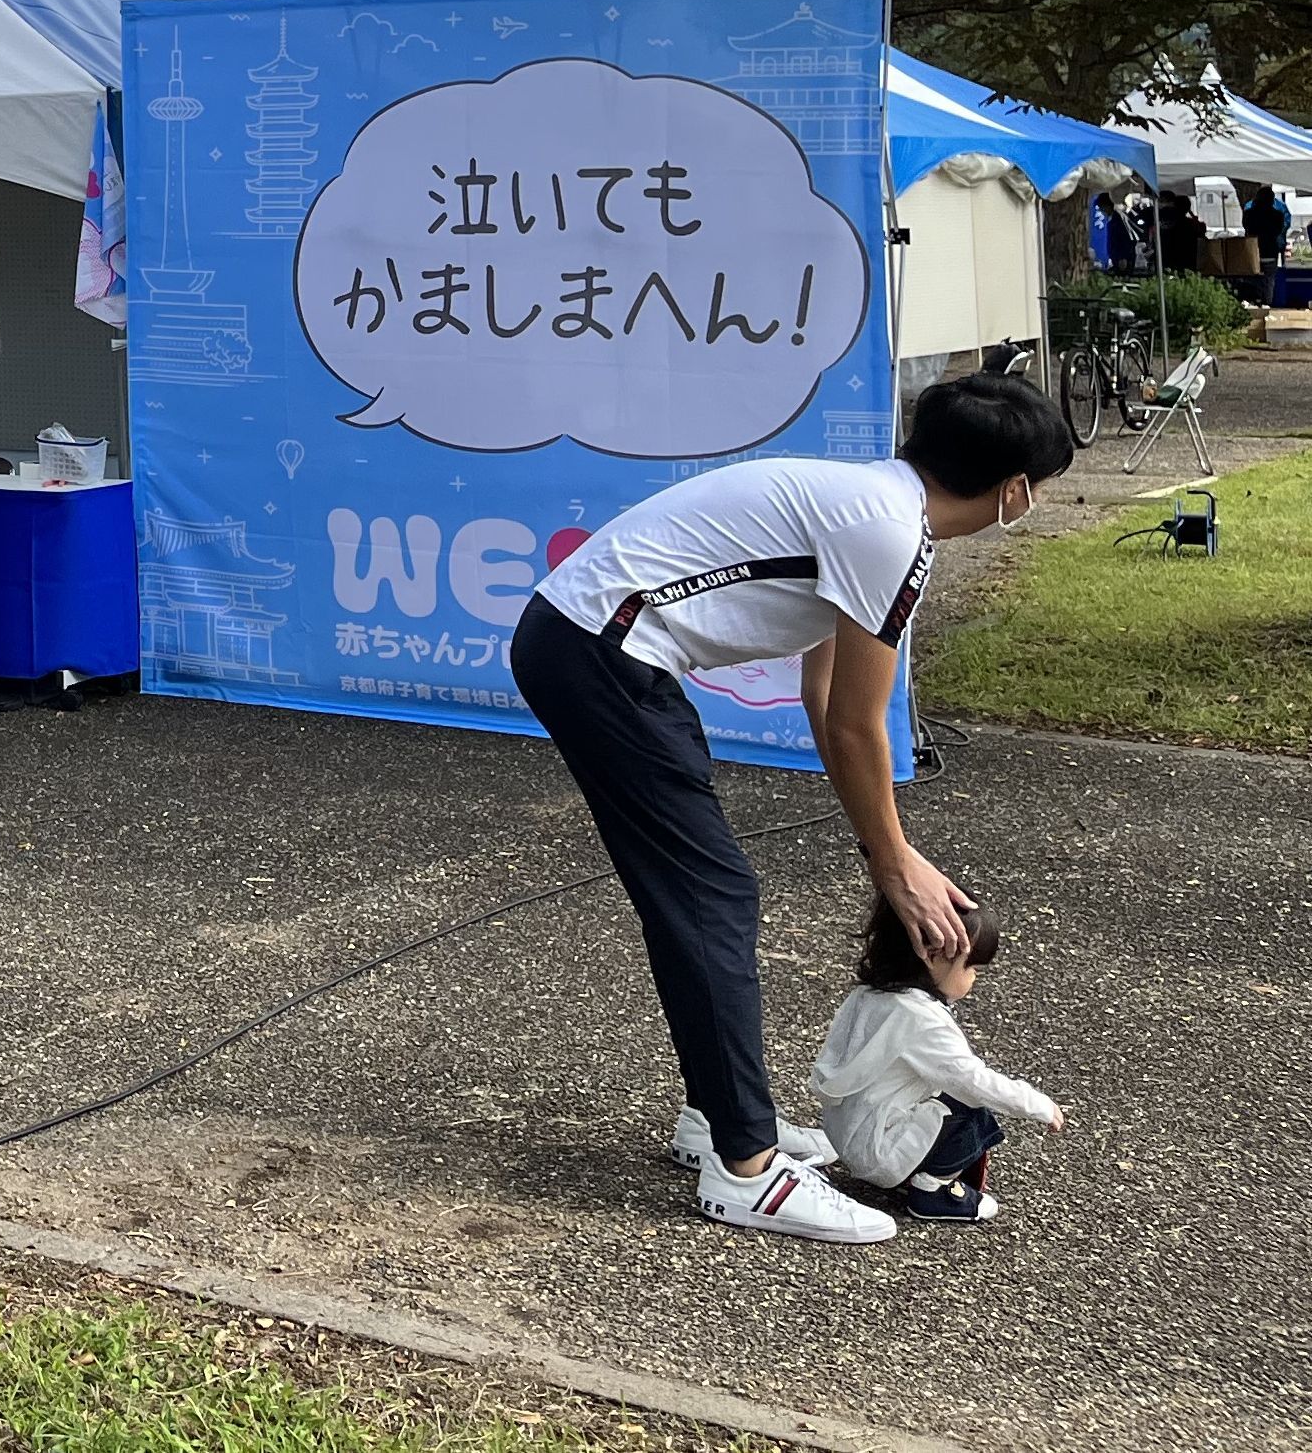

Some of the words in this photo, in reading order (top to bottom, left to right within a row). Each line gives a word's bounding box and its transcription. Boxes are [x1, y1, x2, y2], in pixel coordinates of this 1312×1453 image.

[428, 157, 702, 235] 泣いても
[333, 257, 814, 347] かましまへん!
[640, 583, 686, 605] RALPH
[686, 564, 752, 594] LAUREN
